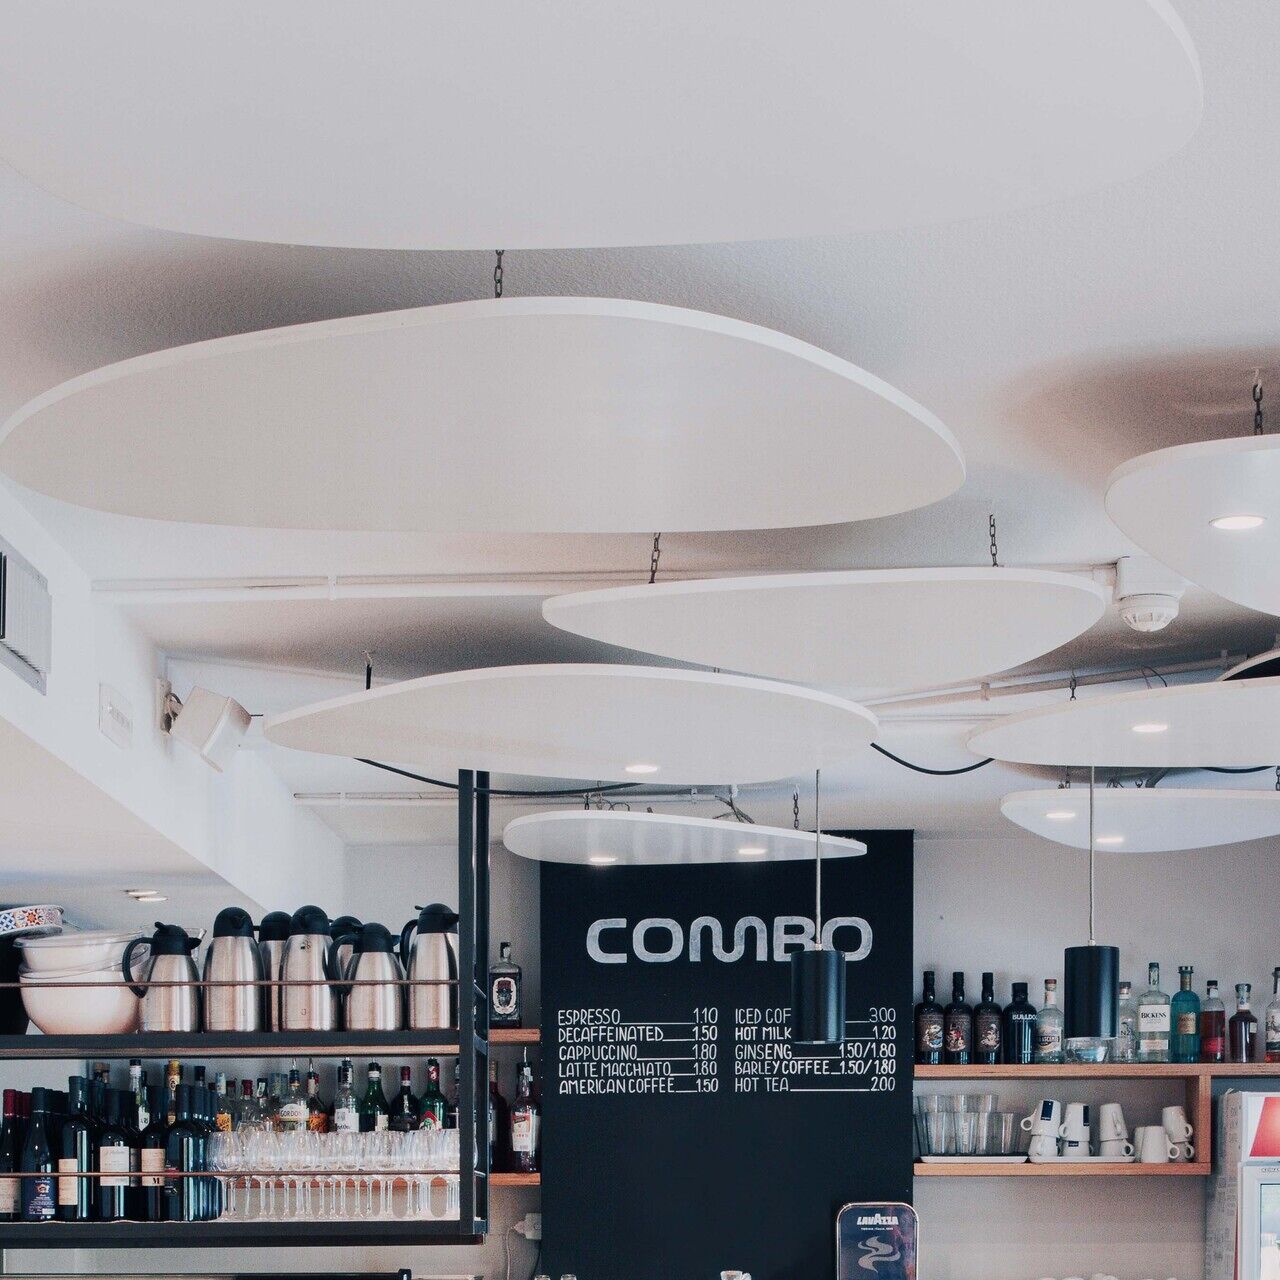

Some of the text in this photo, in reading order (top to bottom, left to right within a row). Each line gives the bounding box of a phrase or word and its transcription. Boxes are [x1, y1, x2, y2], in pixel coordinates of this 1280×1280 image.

[586, 915, 873, 964] COMBO
[558, 1007, 719, 1025] ESPRESSO 1.10
[735, 1007, 896, 1024] ICED COF 3.00
[558, 1025, 718, 1043] DECAFFEINATED 1.50
[735, 1025, 897, 1041] HOT MILK 1.20
[558, 1043, 718, 1061] CAPPUCCINO 1.80
[735, 1042, 897, 1060] GINSENG 1.50/1.80
[558, 1061, 718, 1078] LATTE MACCHIATO 1.80
[735, 1060, 781, 1075] BARLEY
[782, 1060, 830, 1075] COFFEE
[559, 1078, 719, 1094] AMERICAN COFFEE 1.50
[735, 1076, 896, 1093] HOT TEA 2.00
[856, 1213, 899, 1225] LAVAZZA
